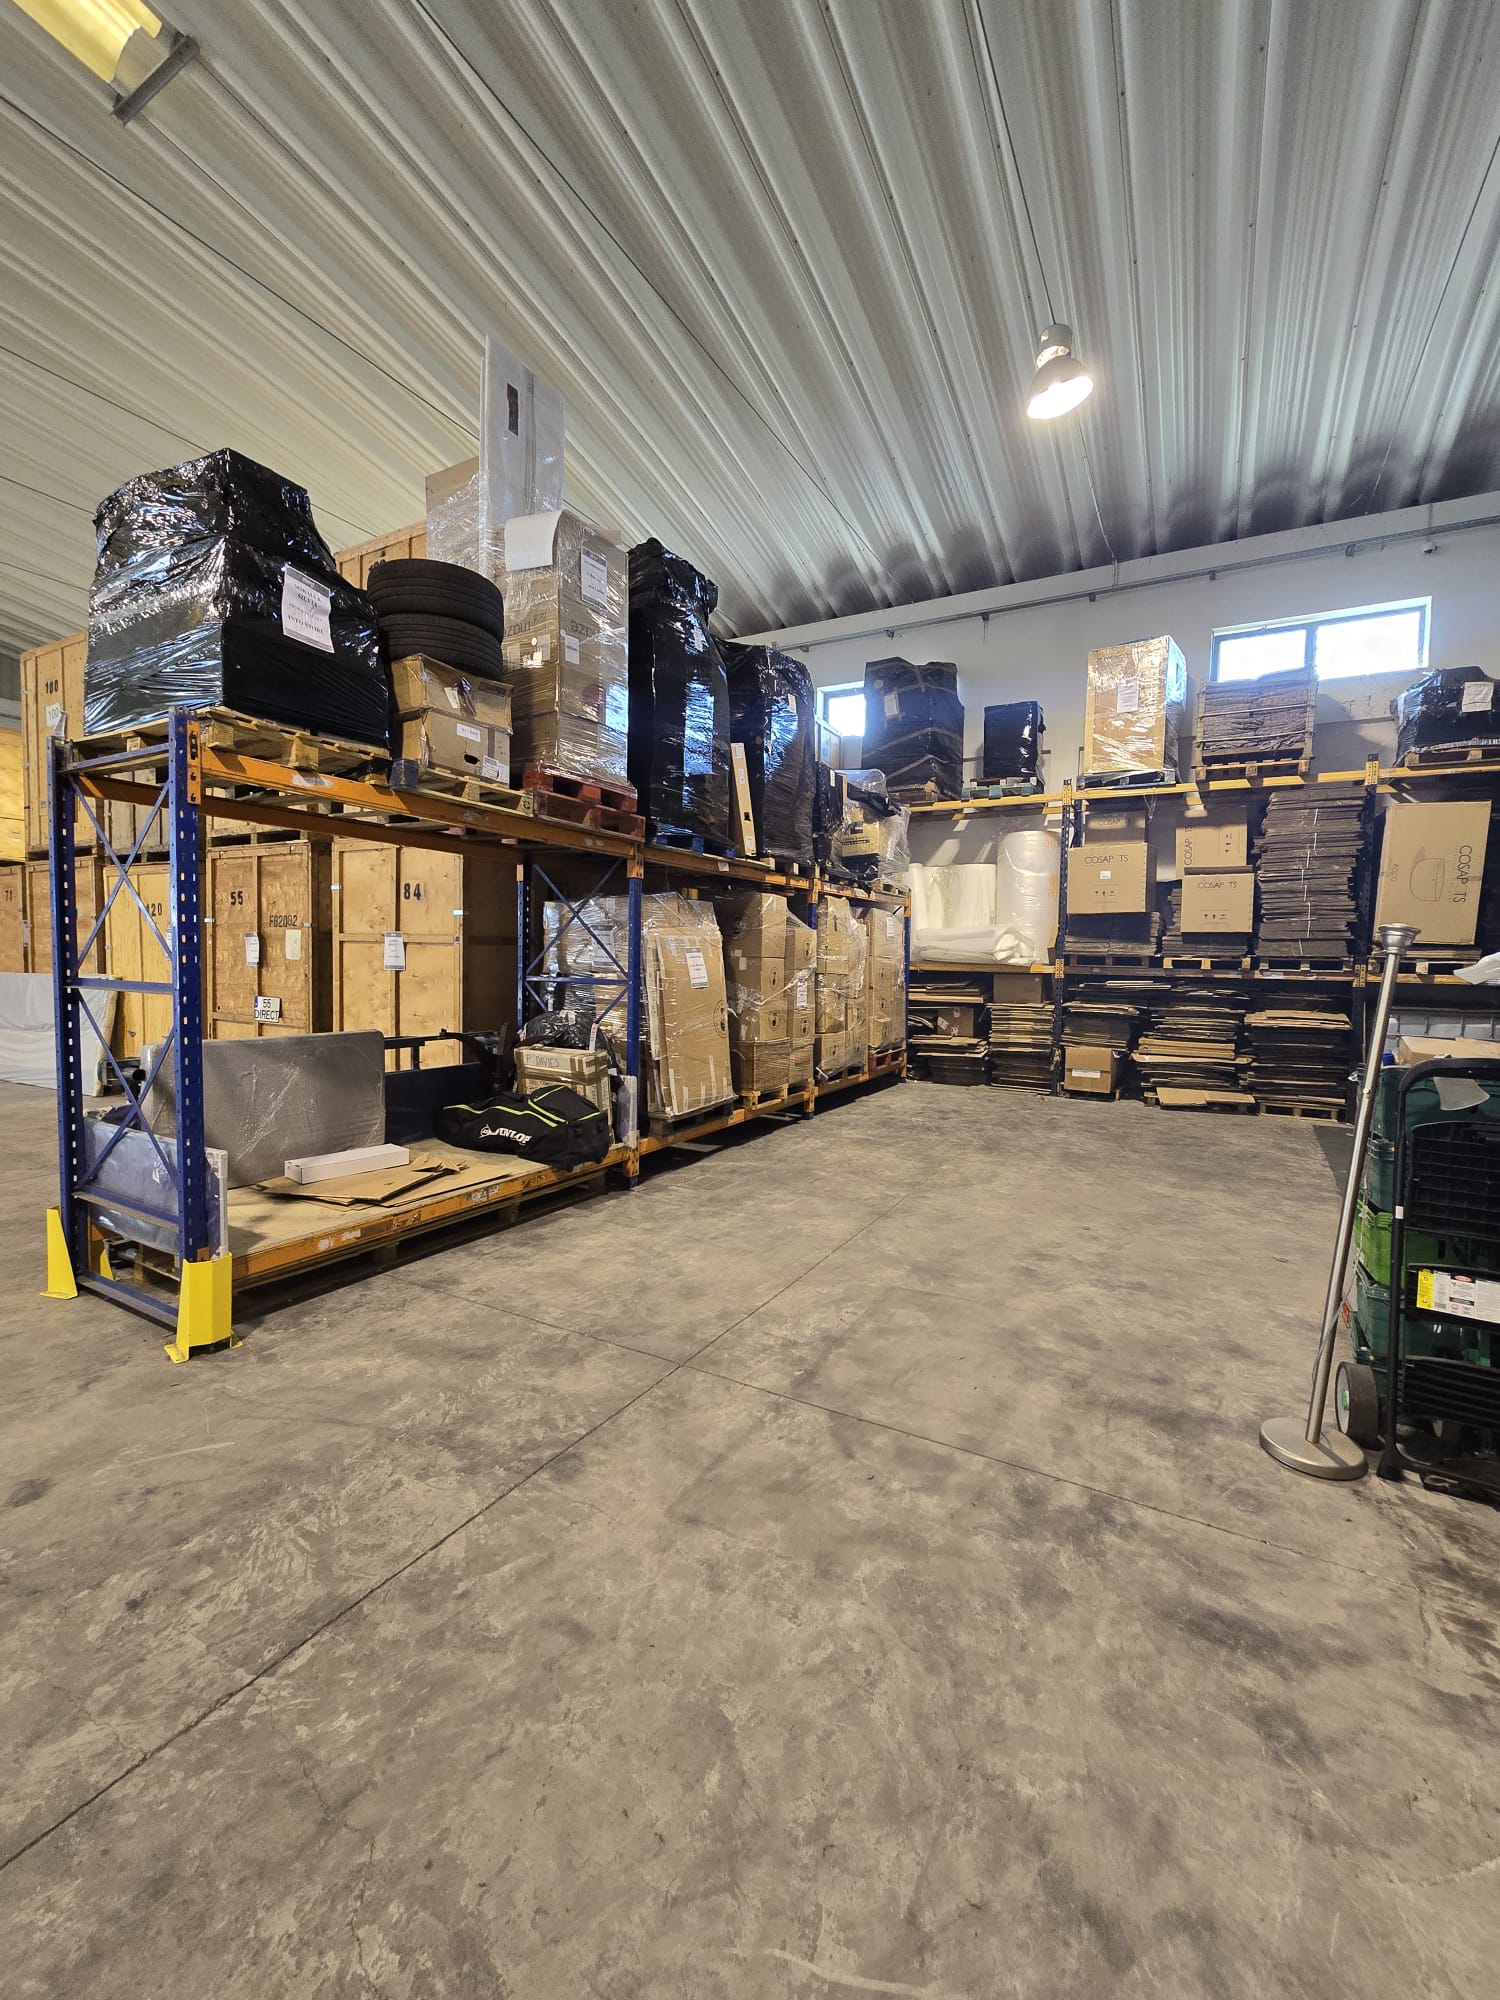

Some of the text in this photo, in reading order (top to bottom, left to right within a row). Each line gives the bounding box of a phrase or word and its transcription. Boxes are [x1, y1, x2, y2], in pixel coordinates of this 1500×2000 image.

[45, 679, 59, 695] 100
[1184, 838, 1193, 866] COSAP
[1084, 854, 1129, 865] COSAP TS
[1456, 844, 1473, 885] COSAP
[403, 882, 422, 901] 84
[1197, 881, 1238, 889] COSAP TS
[4, 890, 13, 902] 71
[230, 890, 244, 906] 55
[1453, 892, 1467, 903] TS
[262, 998, 272, 1009] 55
[253, 1009, 279, 1021] DIRECT
[526, 1053, 560, 1068] P DAVIES
